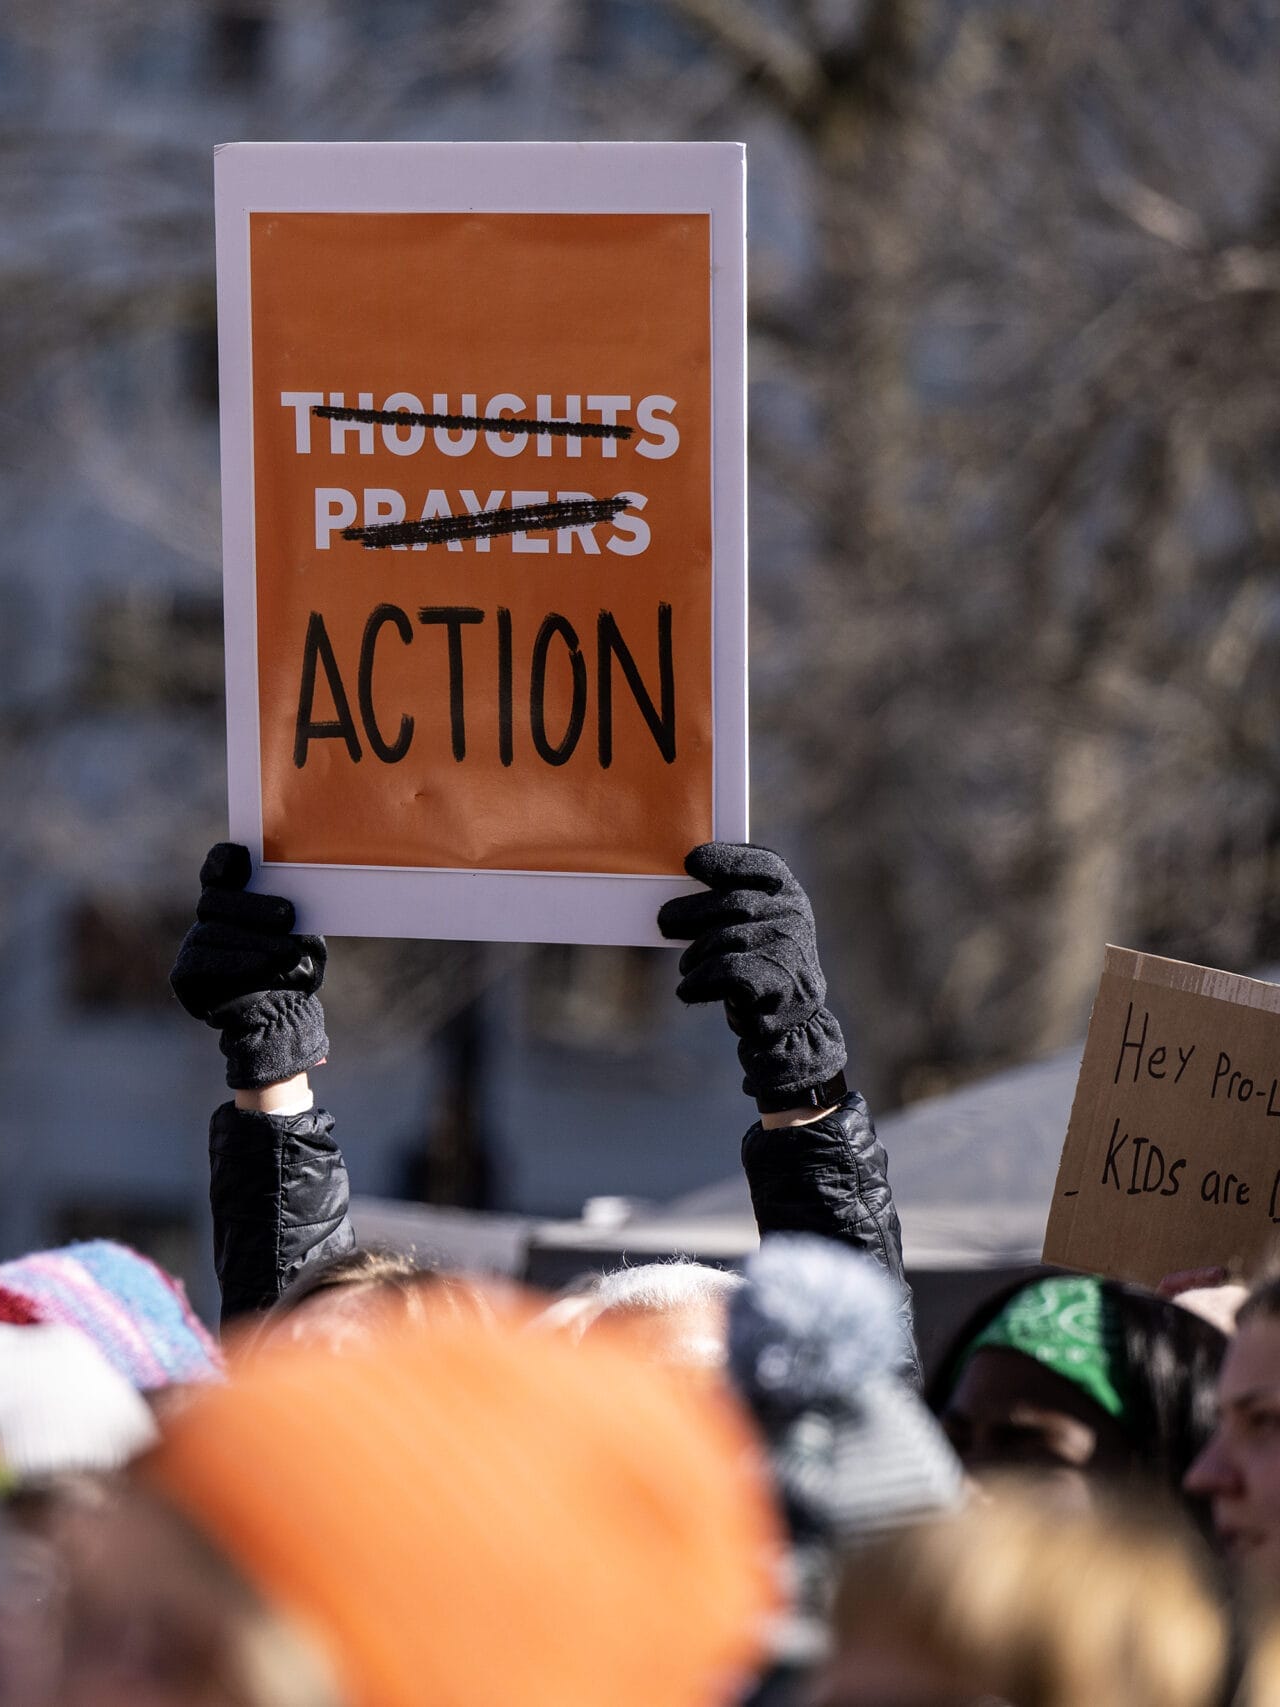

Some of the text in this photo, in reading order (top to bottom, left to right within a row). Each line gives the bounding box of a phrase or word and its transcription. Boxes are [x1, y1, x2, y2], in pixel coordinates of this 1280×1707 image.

[280, 391, 681, 460] THOUGHTS
[314, 487, 652, 557] PRAYERS
[292, 601, 678, 770] ACTION
[1114, 1001, 1196, 1084] Hey
[1200, 1170, 1250, 1206] are
